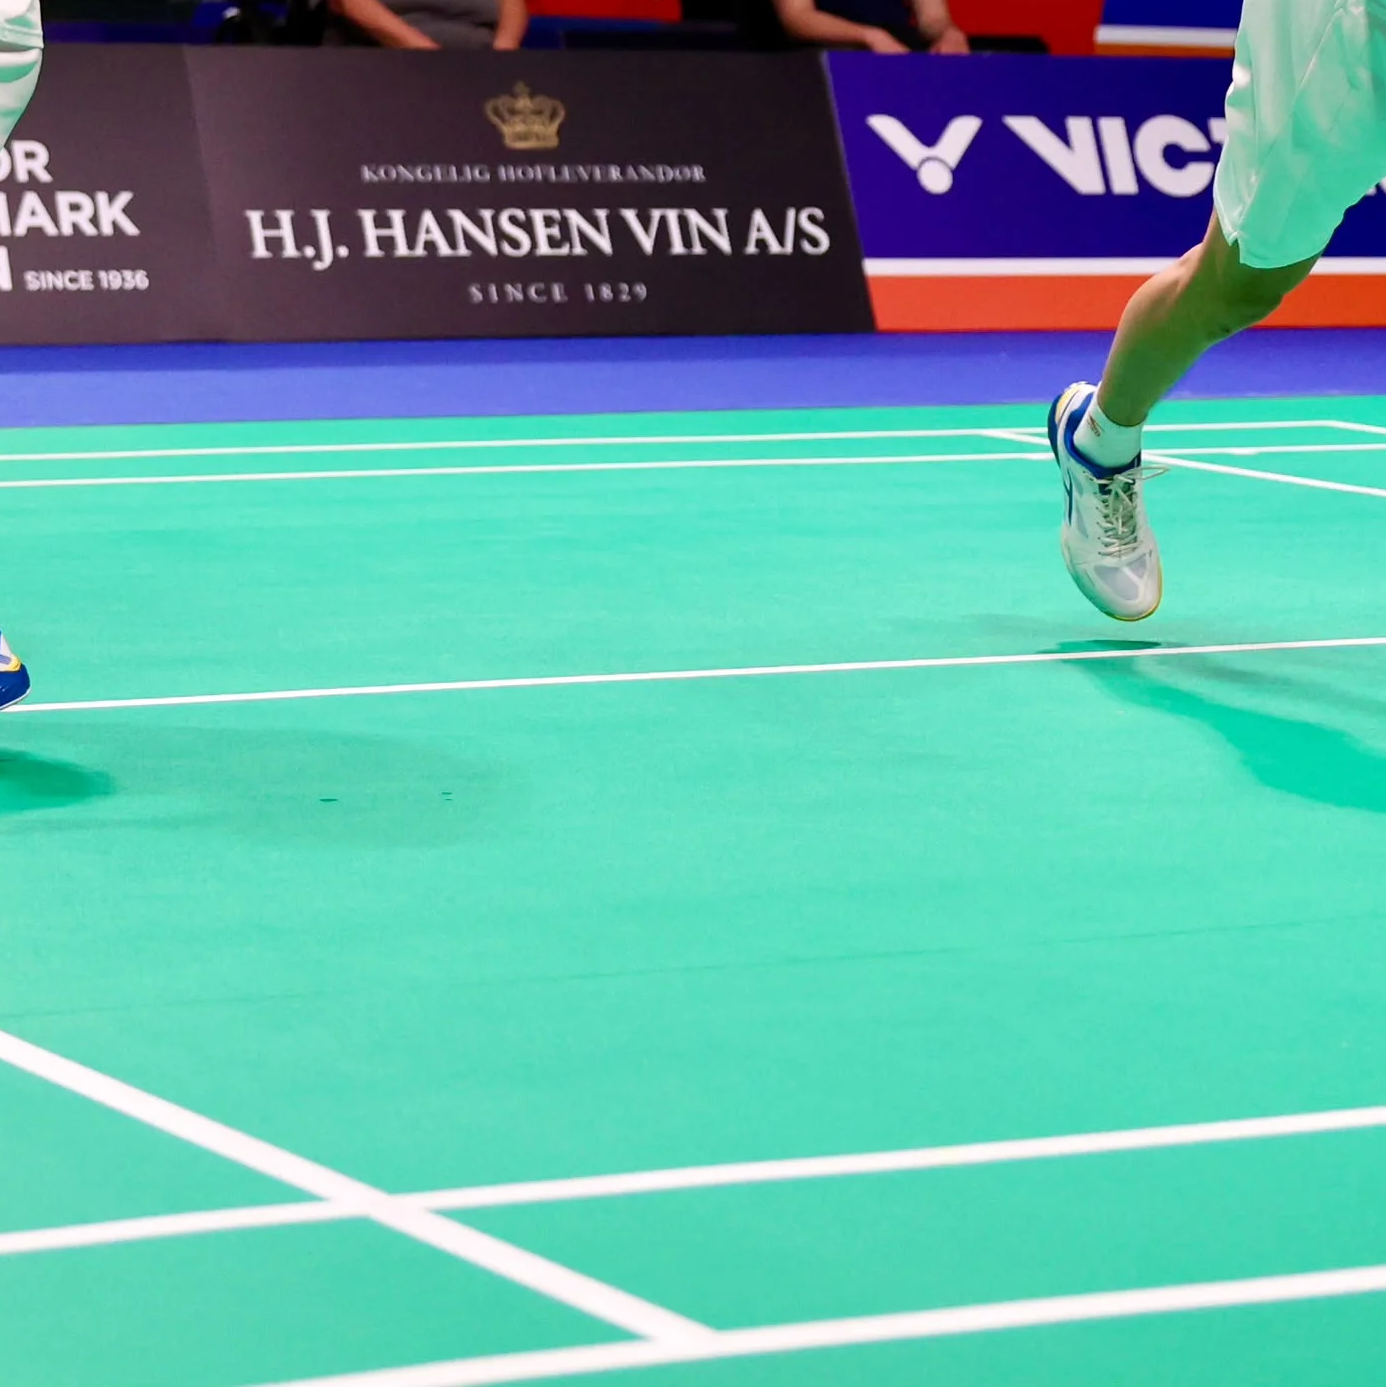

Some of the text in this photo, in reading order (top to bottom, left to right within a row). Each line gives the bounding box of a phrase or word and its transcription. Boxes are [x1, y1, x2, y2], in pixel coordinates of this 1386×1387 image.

[360, 163, 491, 184] KONGELIG
[246, 207, 831, 270] H.J. HANSEN VIN A/S
[24, 269, 94, 291] SINCE
[99, 269, 149, 291] 1936
[469, 282, 649, 304] SINCE 1829
